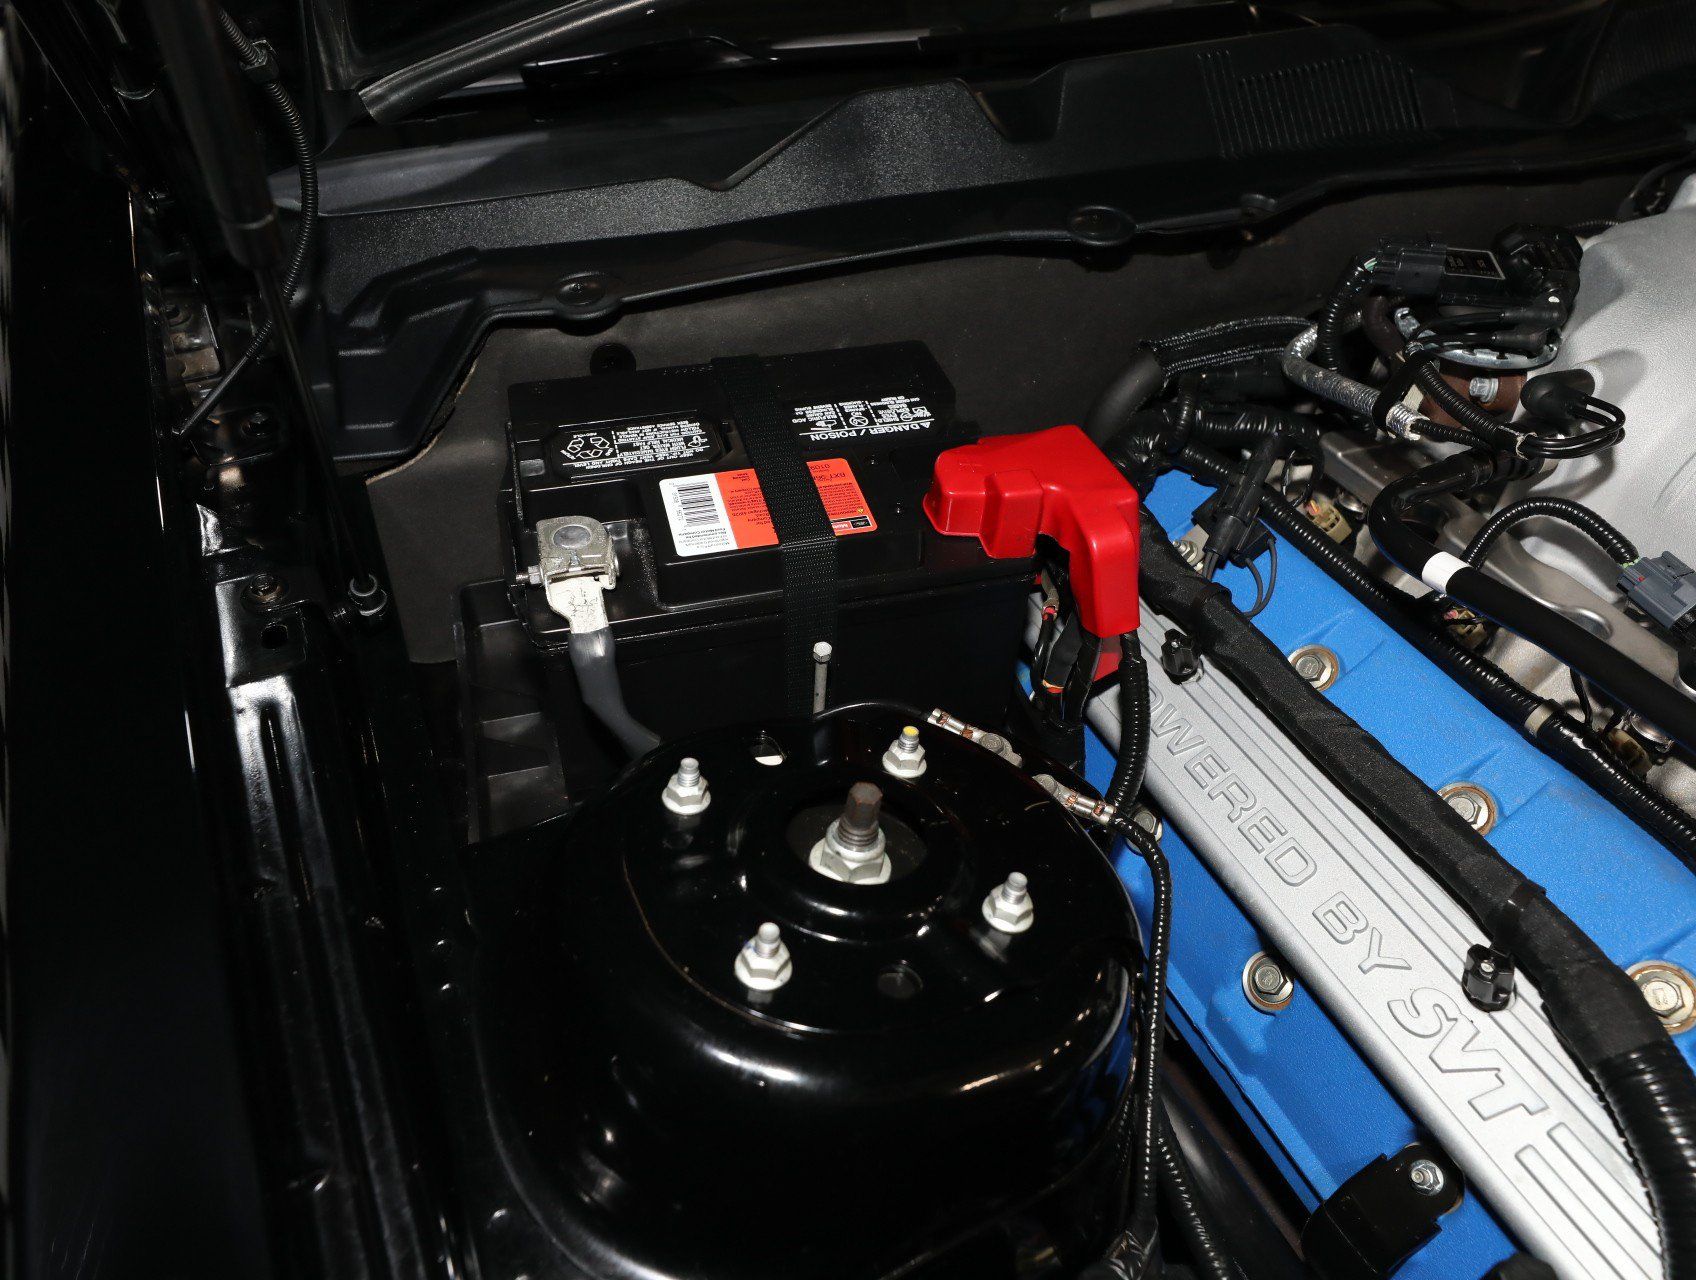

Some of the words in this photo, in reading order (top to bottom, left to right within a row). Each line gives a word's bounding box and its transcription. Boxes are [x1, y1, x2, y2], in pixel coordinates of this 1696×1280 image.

[869, 424, 920, 434] DANGER
[810, 430, 857, 440] POISON
[1149, 684, 1317, 887] WERED
[1312, 891, 1412, 974] BY
[1387, 987, 1550, 1121] SVT
